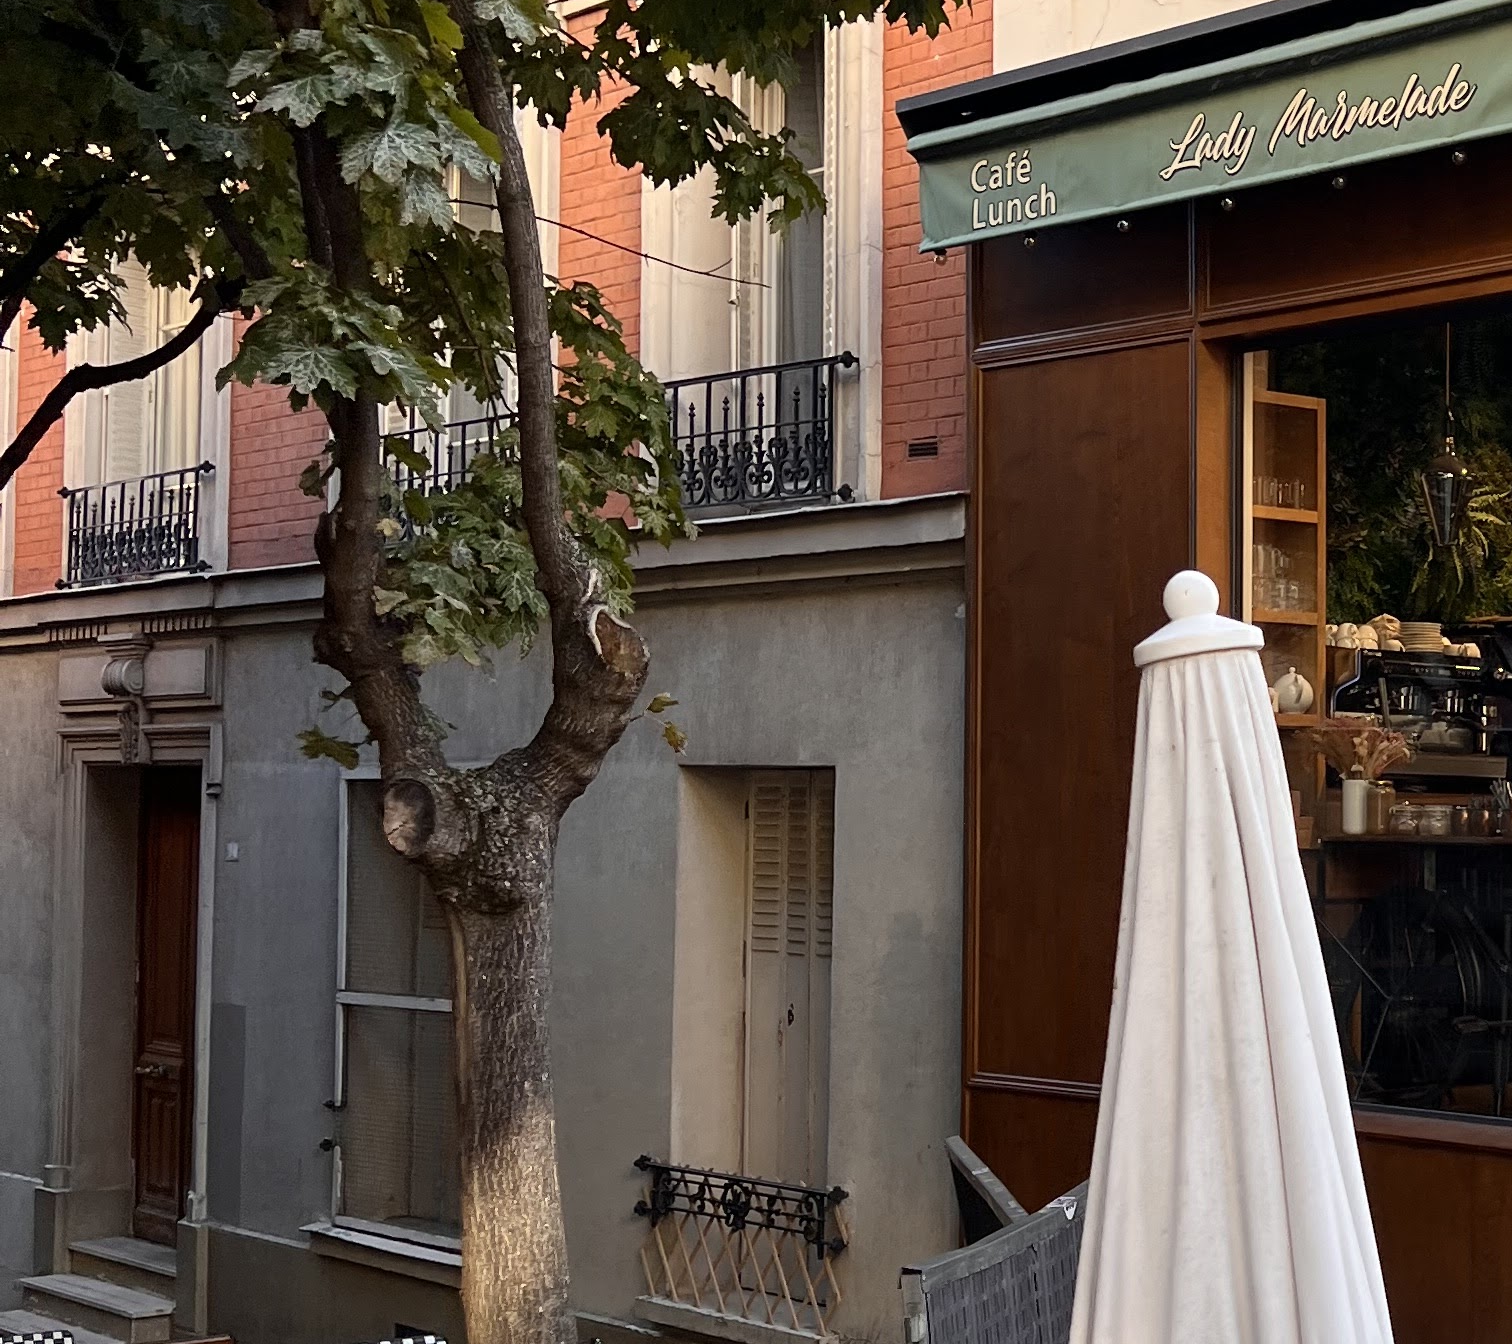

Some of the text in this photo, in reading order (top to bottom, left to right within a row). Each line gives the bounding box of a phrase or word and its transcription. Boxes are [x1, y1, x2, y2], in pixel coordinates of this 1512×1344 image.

[1159, 62, 1478, 181] Lady Marmelade
[970, 148, 1033, 194] Café
[971, 186, 1058, 231] Lunch
